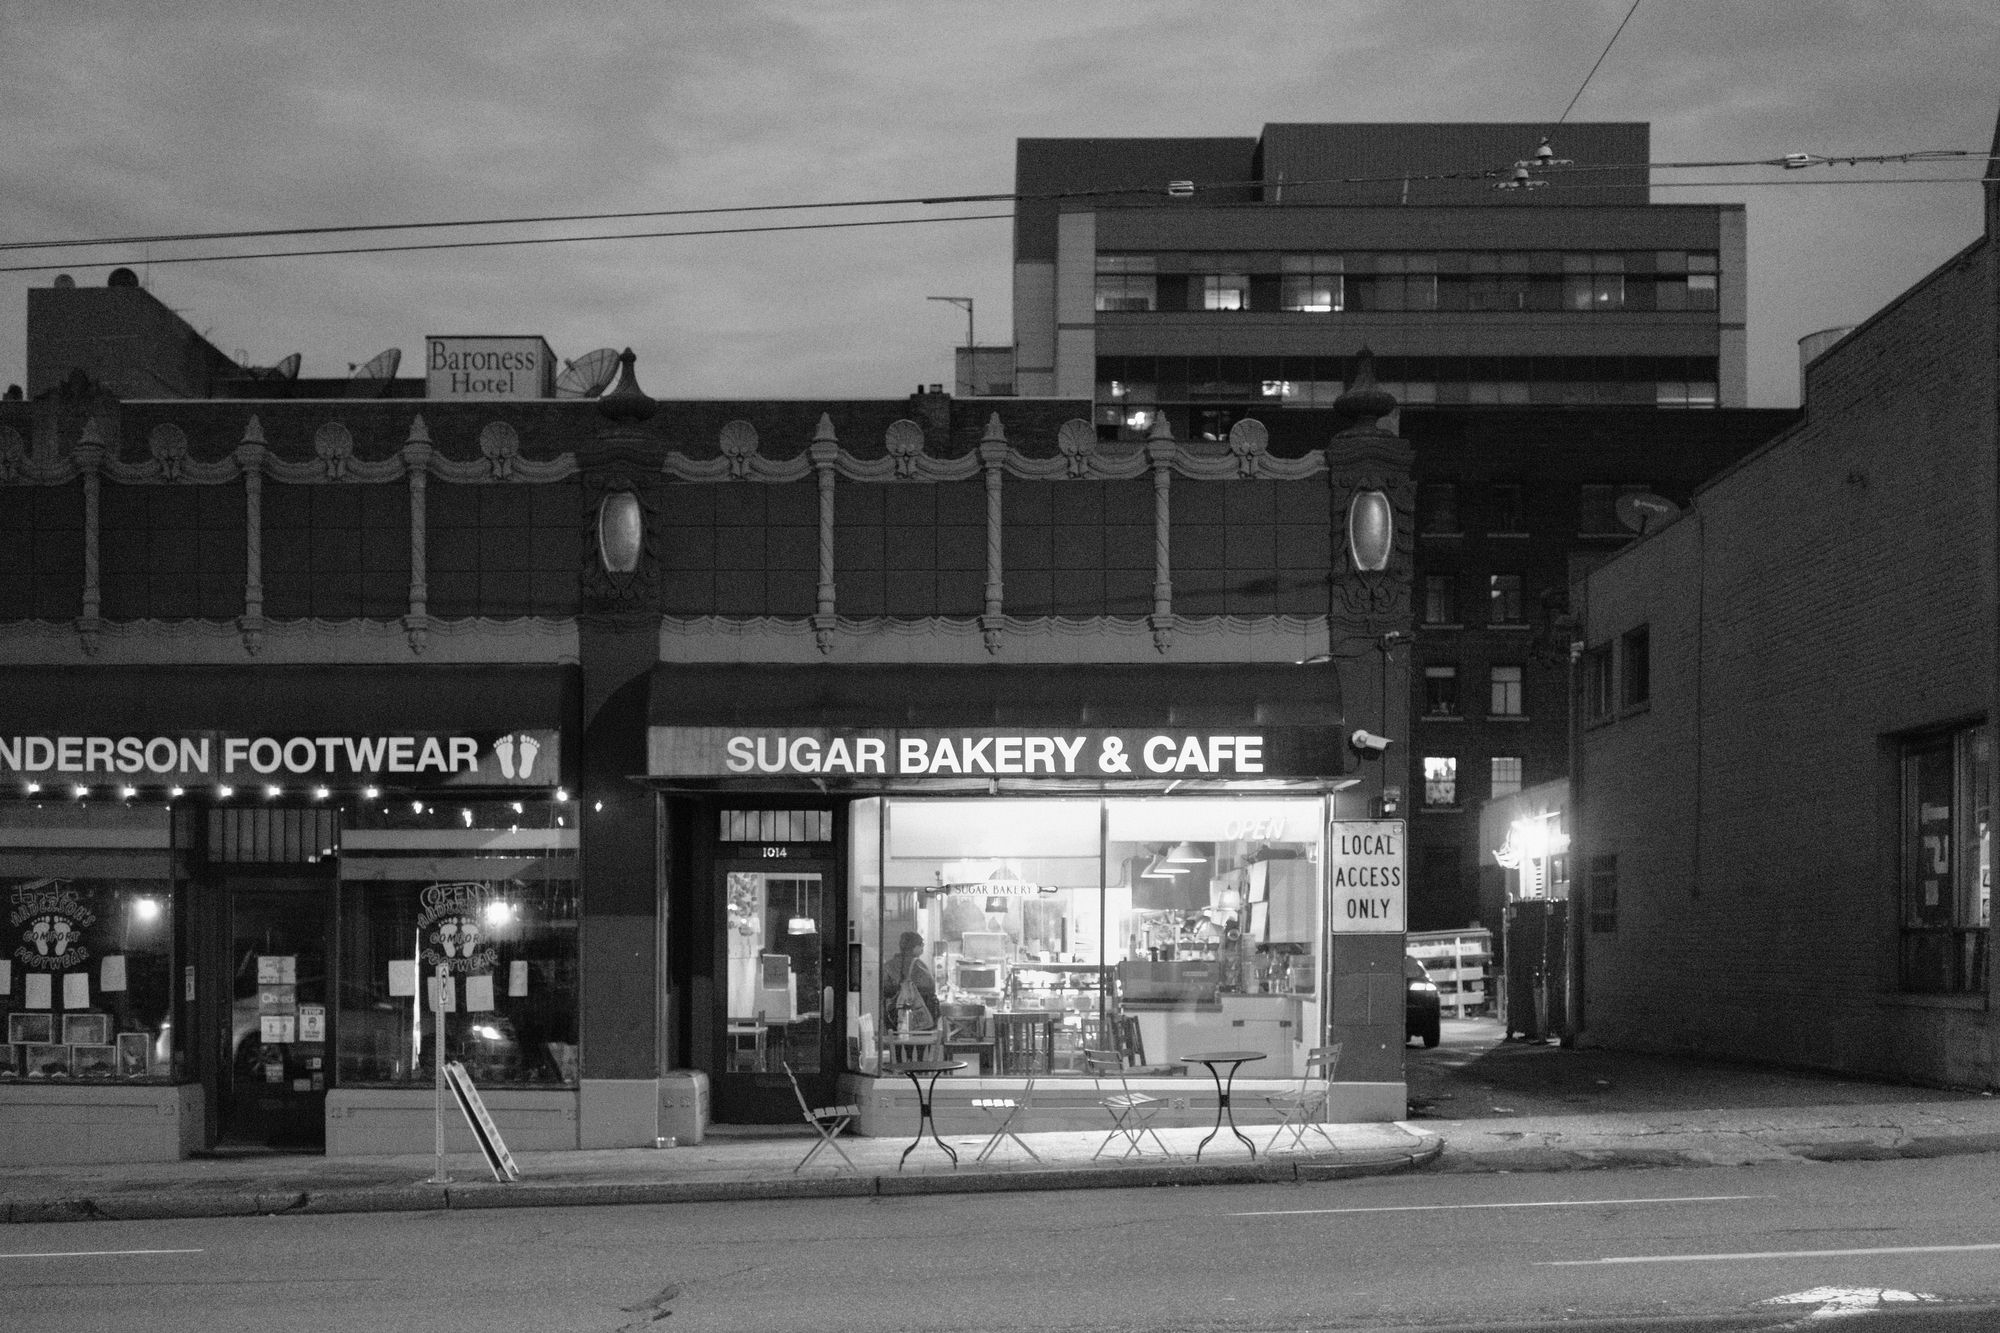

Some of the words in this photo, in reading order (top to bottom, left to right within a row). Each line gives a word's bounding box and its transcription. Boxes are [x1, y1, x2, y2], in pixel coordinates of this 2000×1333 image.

[432, 341, 535, 371] Baroness
[451, 372, 514, 393] Hotel
[0, 737, 210, 773] NDERSON
[225, 737, 479, 773] FOOTWEAR
[726, 736, 885, 774] SUGAR
[899, 736, 1086, 774] BAKERY
[1098, 736, 1130, 774] &
[1143, 736, 1264, 774] CAFE
[1224, 814, 1286, 840] OPEN
[762, 847, 788, 858] 1014
[1341, 834, 1396, 856] LOCAL
[1335, 866, 1401, 888] ACCESS
[427, 885, 480, 905] OPEN
[954, 884, 988, 895] SUGAR
[993, 884, 1032, 895] BAKERY
[1346, 898, 1391, 919] ONLY
[22, 930, 81, 943] COMFORT
[14, 946, 90, 970] FOOTWEAR
